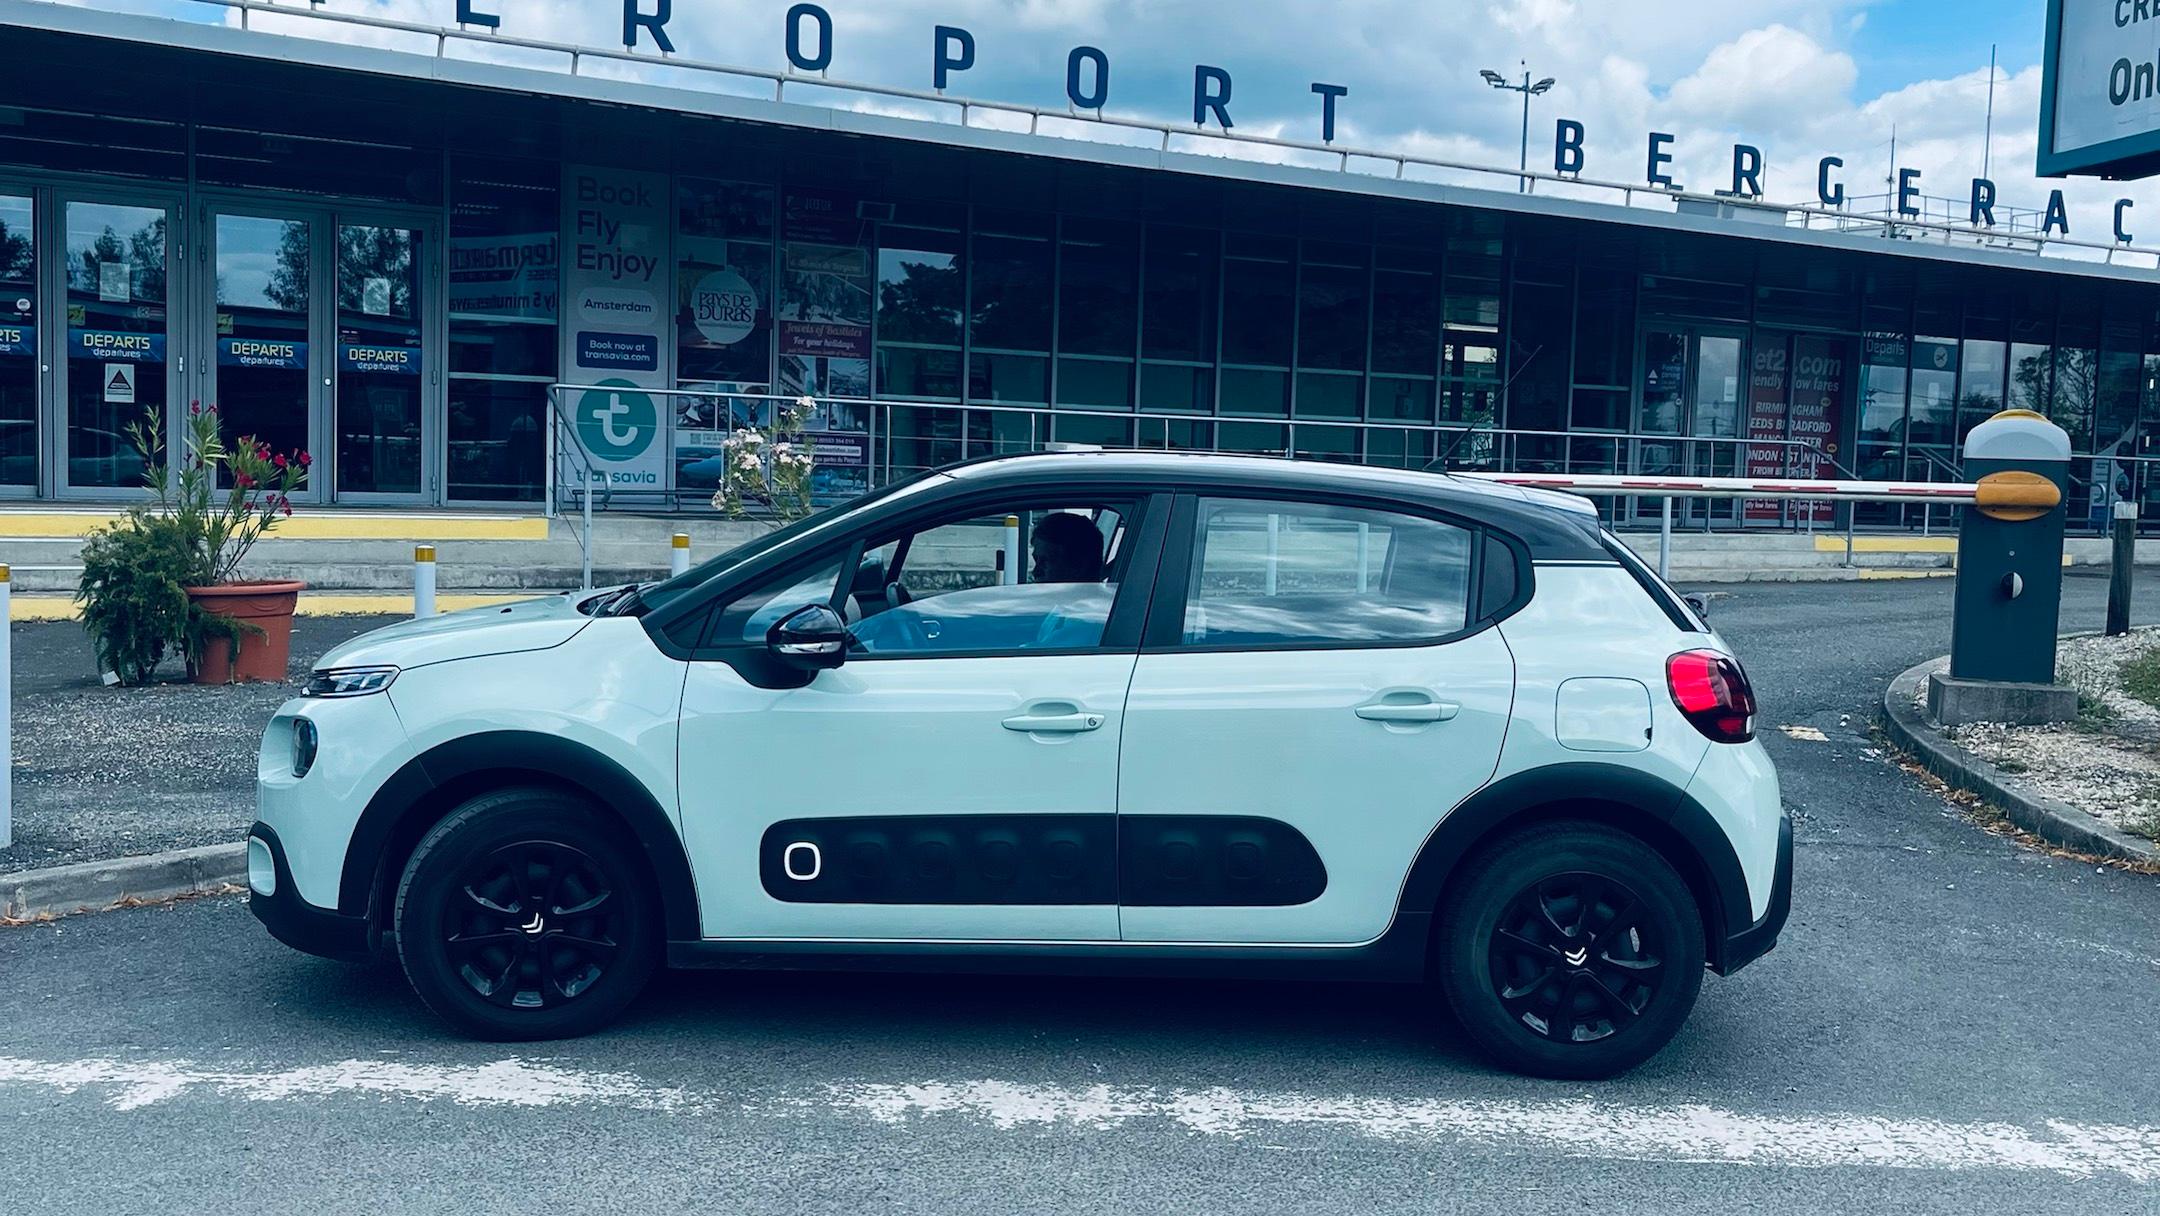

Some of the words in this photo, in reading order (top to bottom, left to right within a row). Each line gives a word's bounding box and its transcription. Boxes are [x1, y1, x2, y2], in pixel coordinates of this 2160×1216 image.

[311, 0, 1347, 141] ROPORT
[1554, 118, 2133, 242] BERGERAC
[577, 175, 653, 208] Book
[577, 209, 620, 245] Fly
[577, 243, 658, 282] Enjoy
[584, 298, 652, 313] Amsterdam
[93, 347, 141, 359] departures
[589, 339, 613, 351] Book
[614, 342, 634, 351] now
[635, 343, 646, 352] at
[585, 351, 651, 362] transavia.com
[1750, 417, 1774, 430] EEDS
